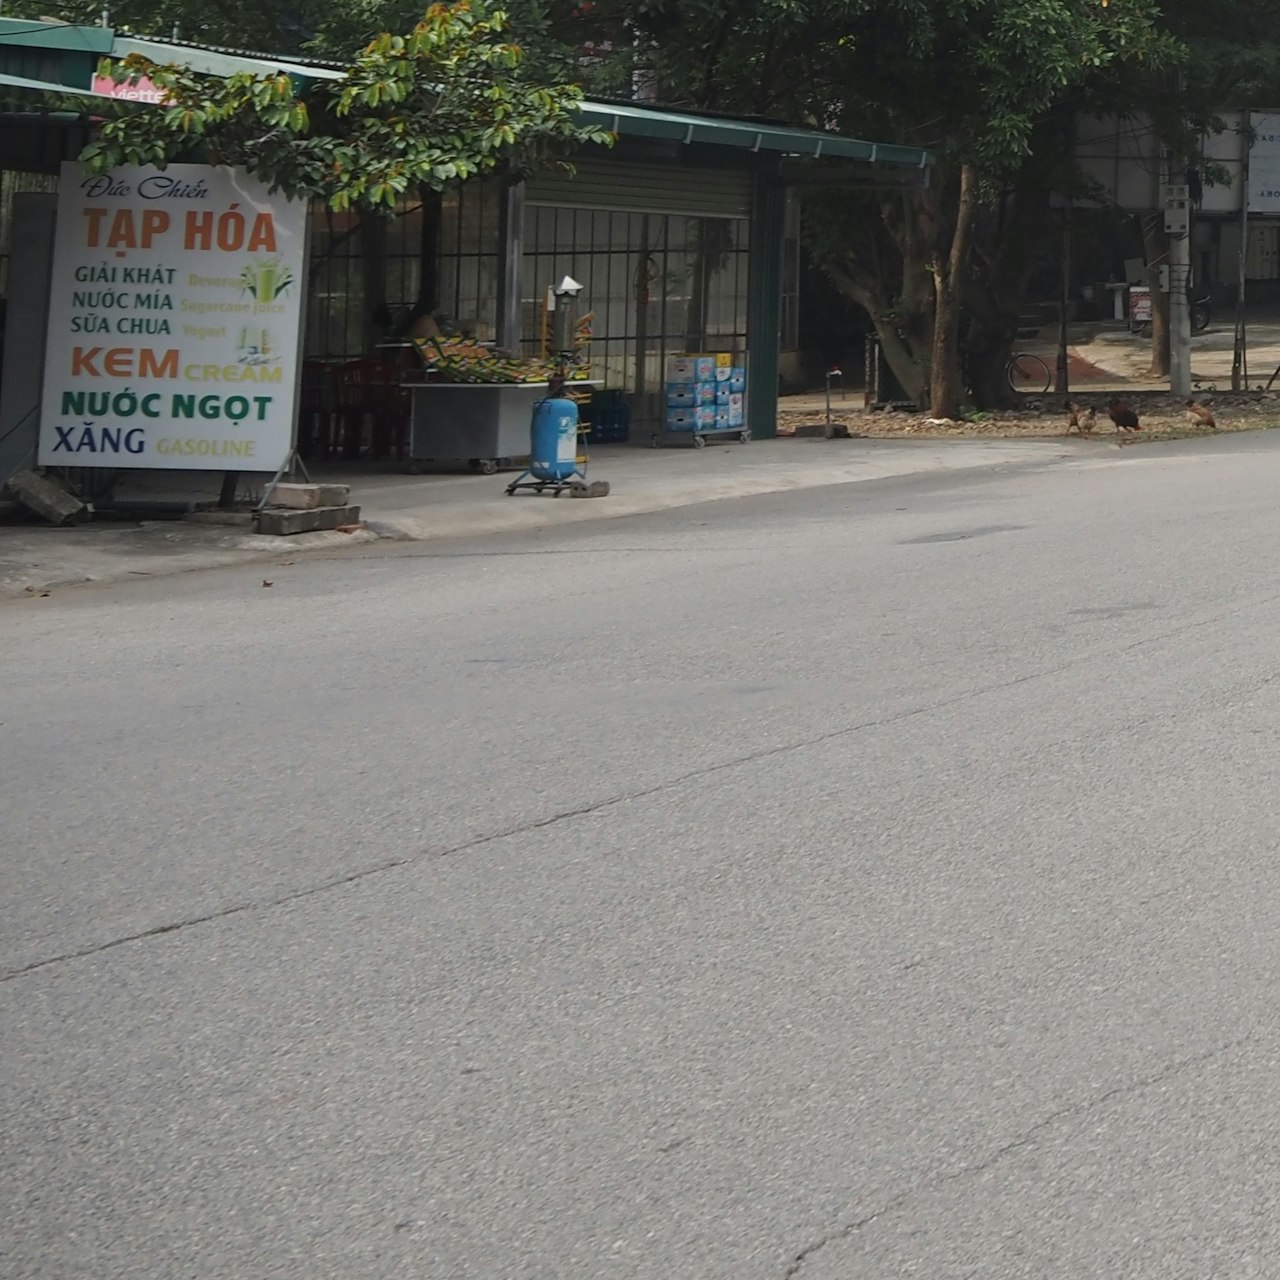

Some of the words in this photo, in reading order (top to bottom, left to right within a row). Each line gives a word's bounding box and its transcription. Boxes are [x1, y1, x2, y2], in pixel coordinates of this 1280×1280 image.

[80, 175, 130, 199] Đức
[138, 175, 209, 200] Chiến
[83, 207, 170, 258] TẠP
[184, 203, 278, 252] HÓA
[75, 261, 117, 283] GIẢI
[122, 264, 177, 284] KHÁT
[72, 288, 129, 309] NƯỚC
[134, 289, 173, 310] MÍA
[70, 313, 110, 333] SỮA
[117, 317, 171, 335] CHUA
[71, 346, 180, 379] KEM
[184, 364, 282, 383] CREAM
[61, 387, 160, 417] NƯỚC
[171, 394, 272, 426] NGỌT
[52, 421, 145, 454] XĂNG
[156, 438, 255, 457] GASOLINE
